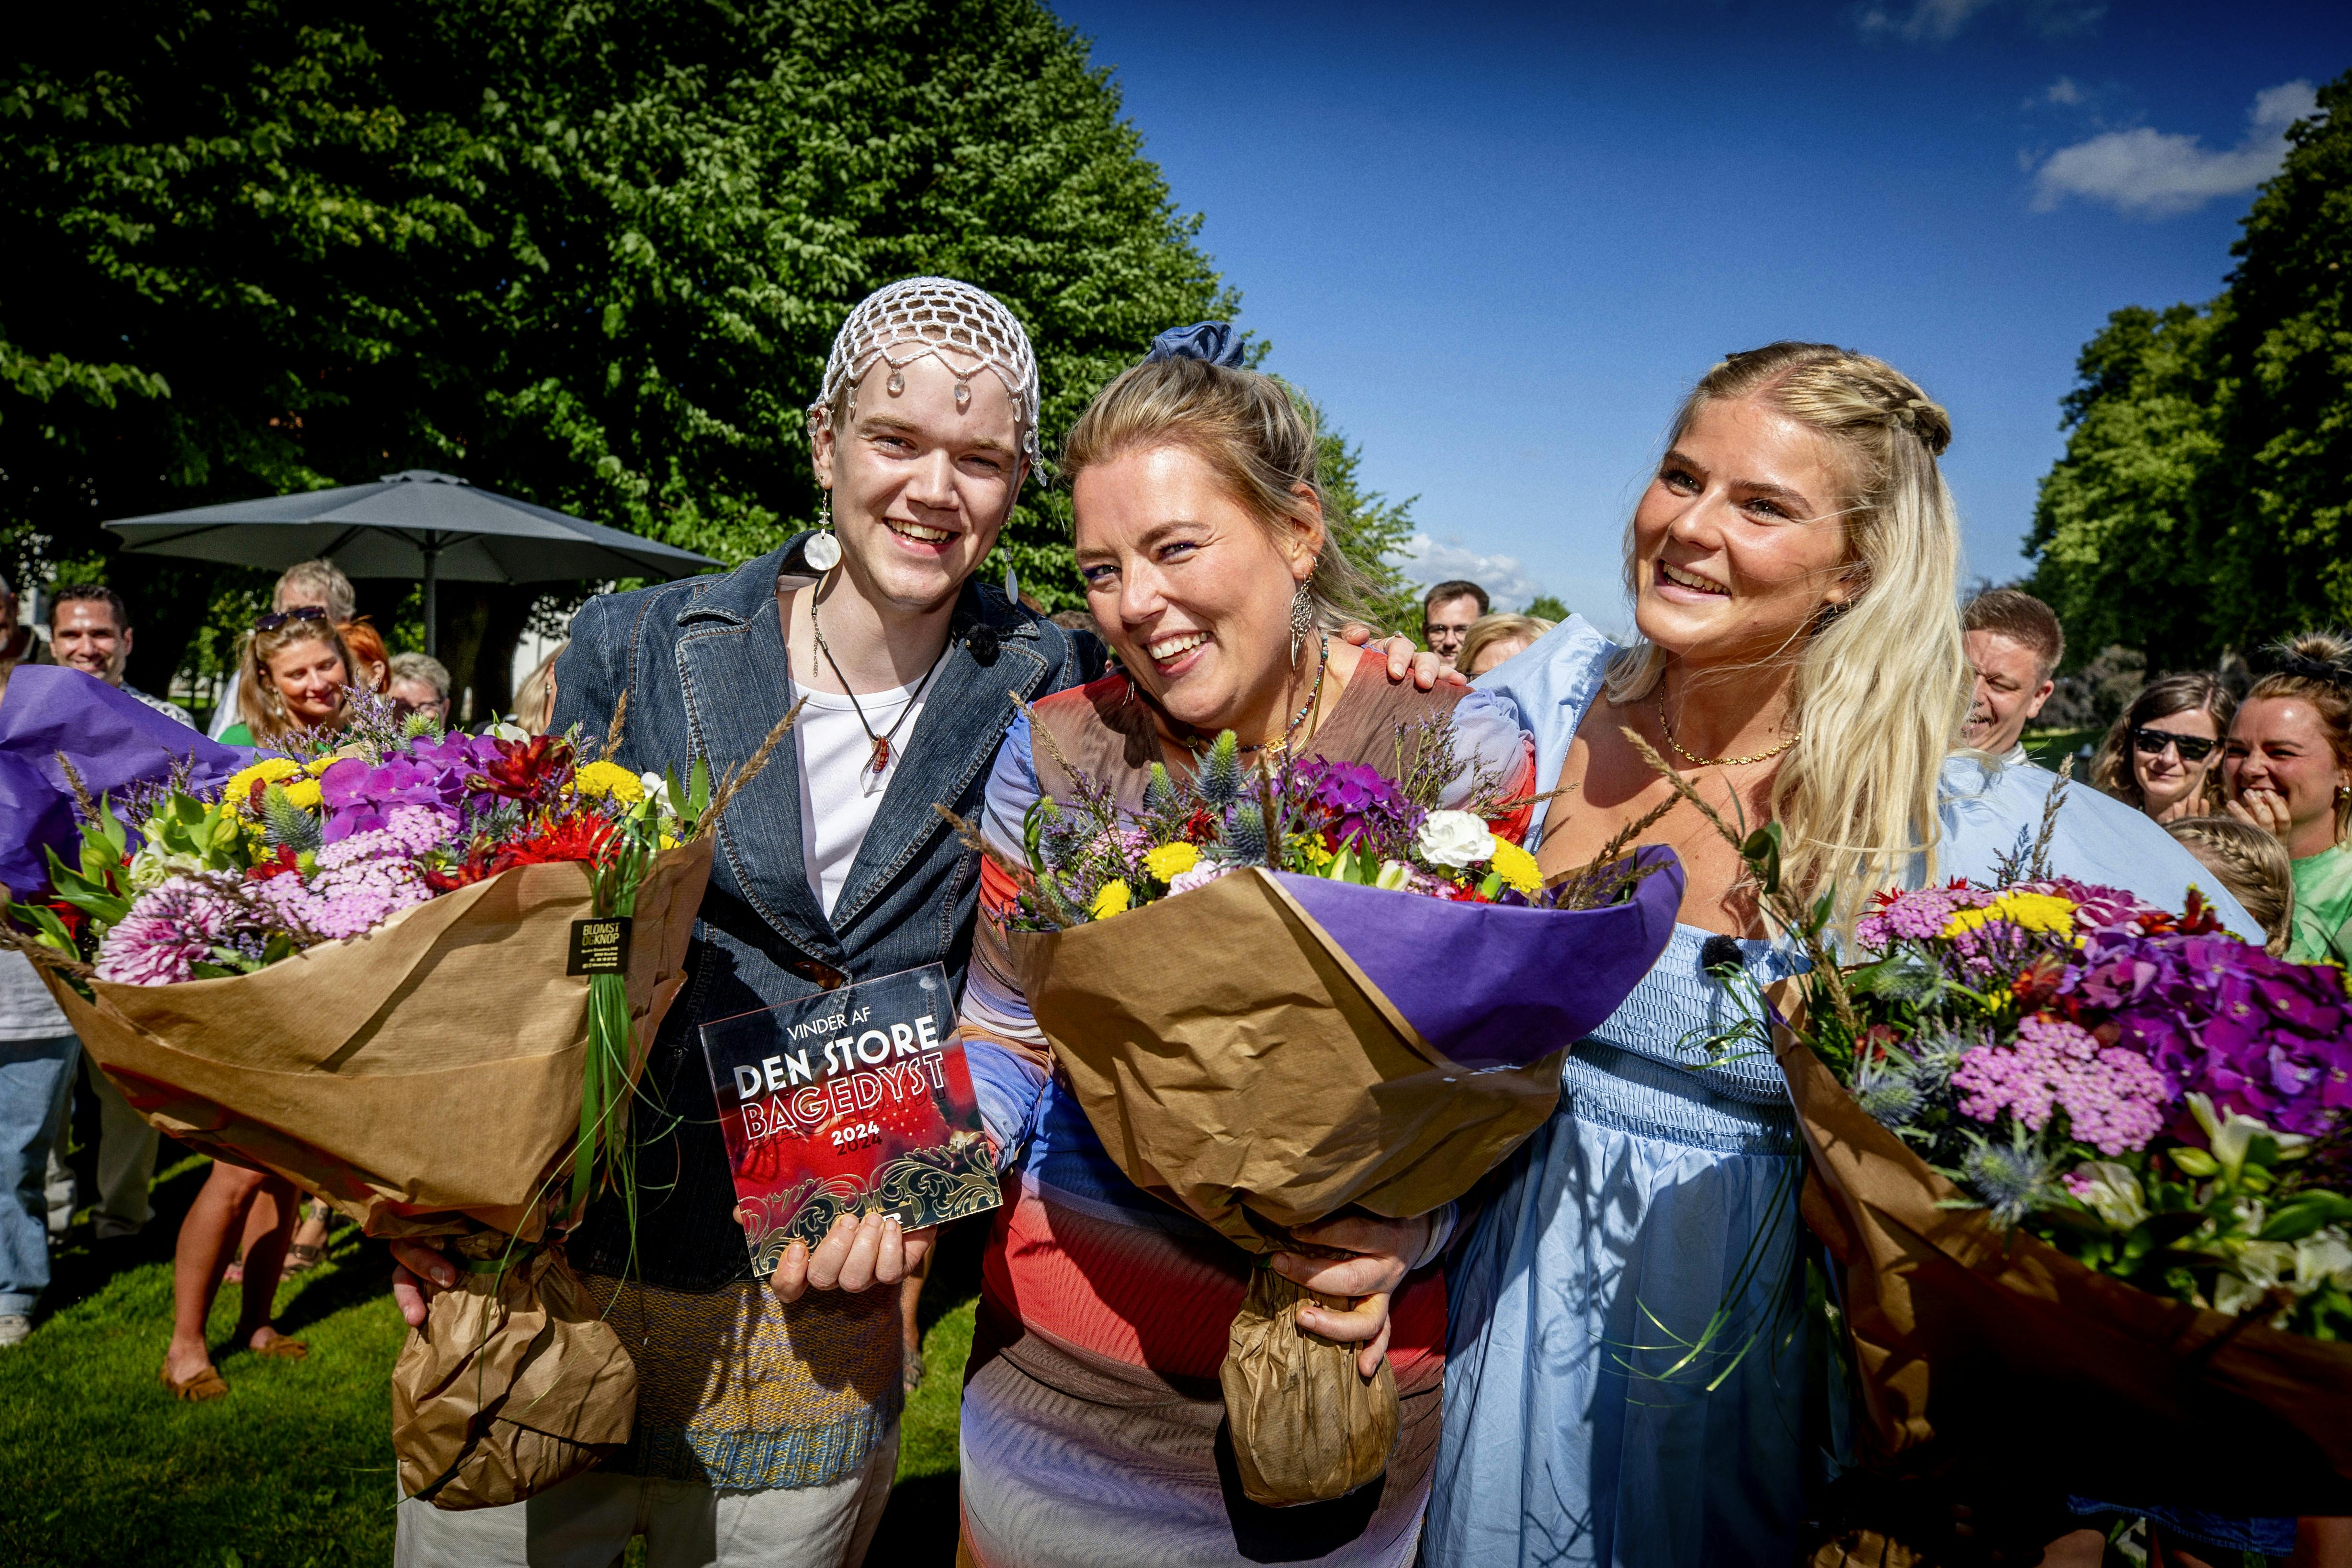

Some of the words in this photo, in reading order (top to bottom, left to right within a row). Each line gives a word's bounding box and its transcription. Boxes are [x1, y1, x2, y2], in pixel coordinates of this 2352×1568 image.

[583, 922, 621, 936] BLOMST
[787, 1014, 848, 1041] VINDER
[851, 1006, 871, 1025] AF
[733, 1049, 813, 1100] DEN
[824, 1015, 939, 1076] STORE
[741, 1051, 945, 1140] BAGEDYST
[831, 1120, 880, 1146] 2024
